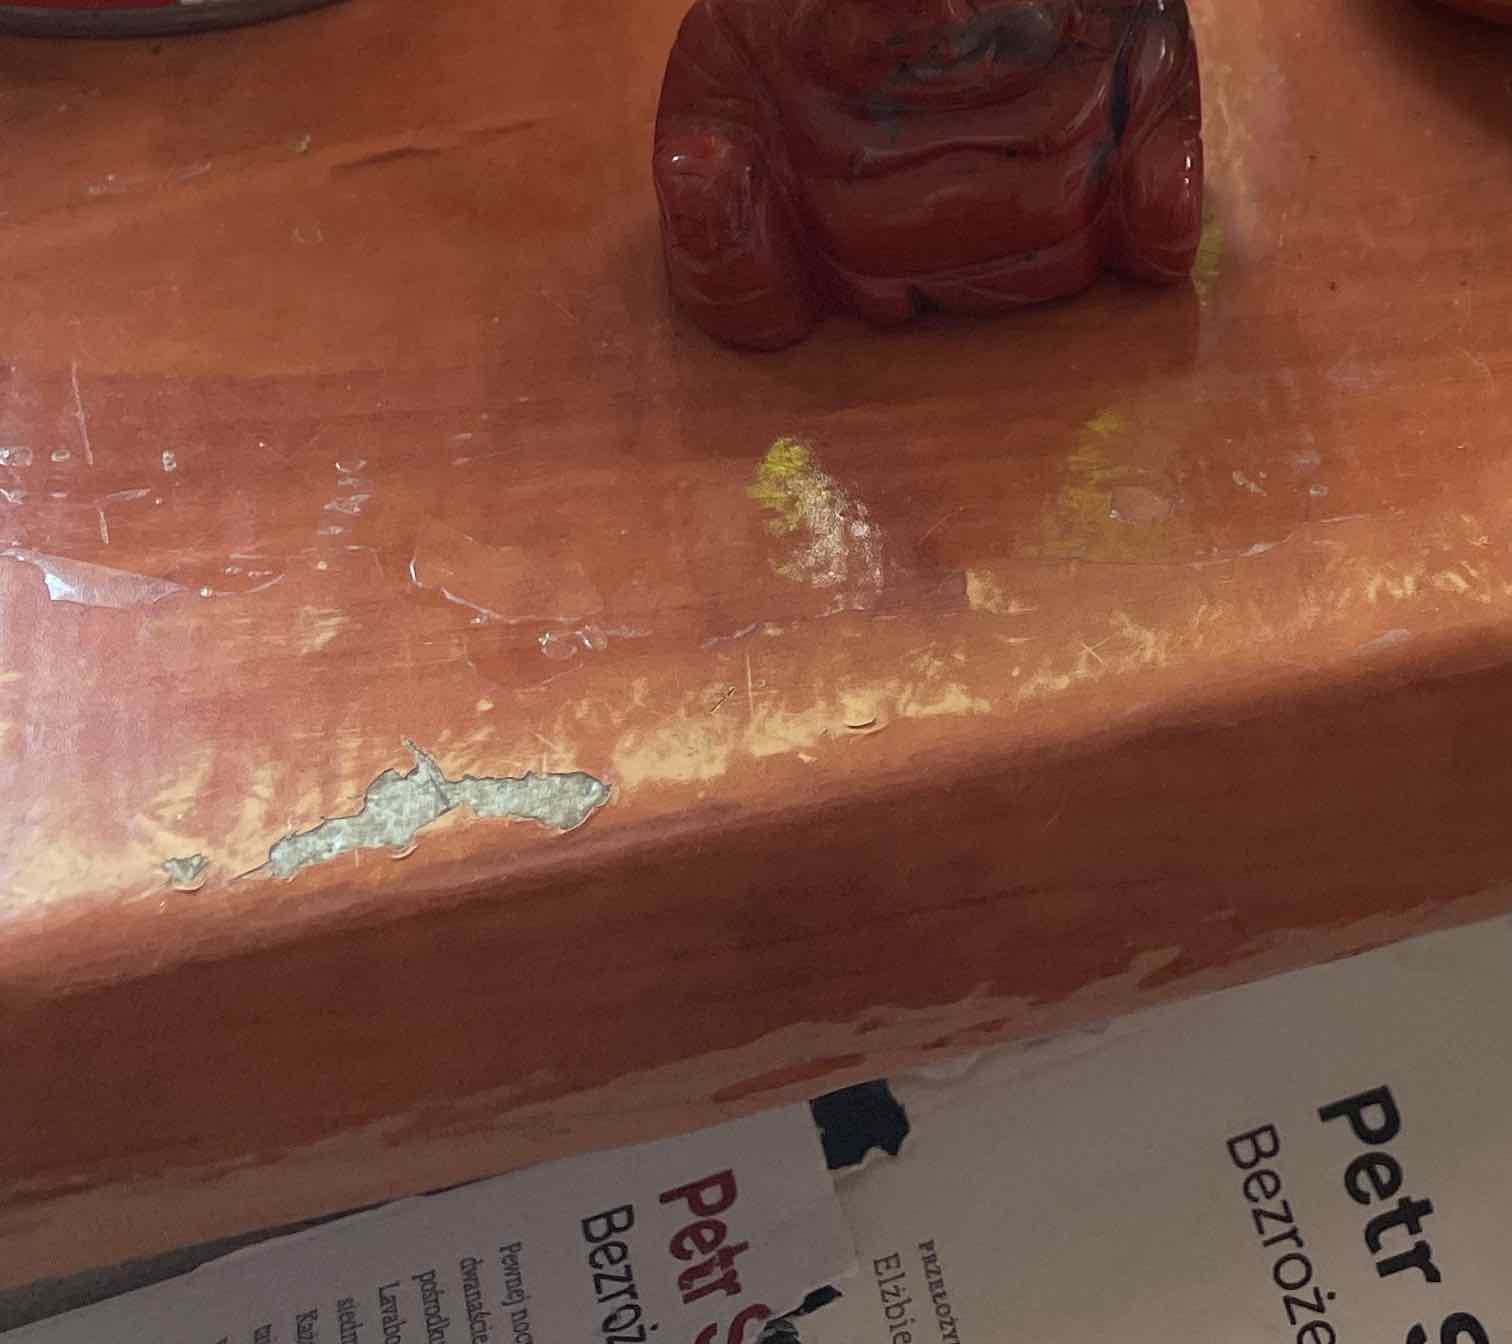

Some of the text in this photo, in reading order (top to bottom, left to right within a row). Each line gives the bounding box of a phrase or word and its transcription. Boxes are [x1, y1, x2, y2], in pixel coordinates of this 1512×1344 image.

[659, 1168, 750, 1305] Petr
[1317, 1084, 1442, 1283] Petr
[918, 1239, 961, 1344] PRZEŁOŻY
